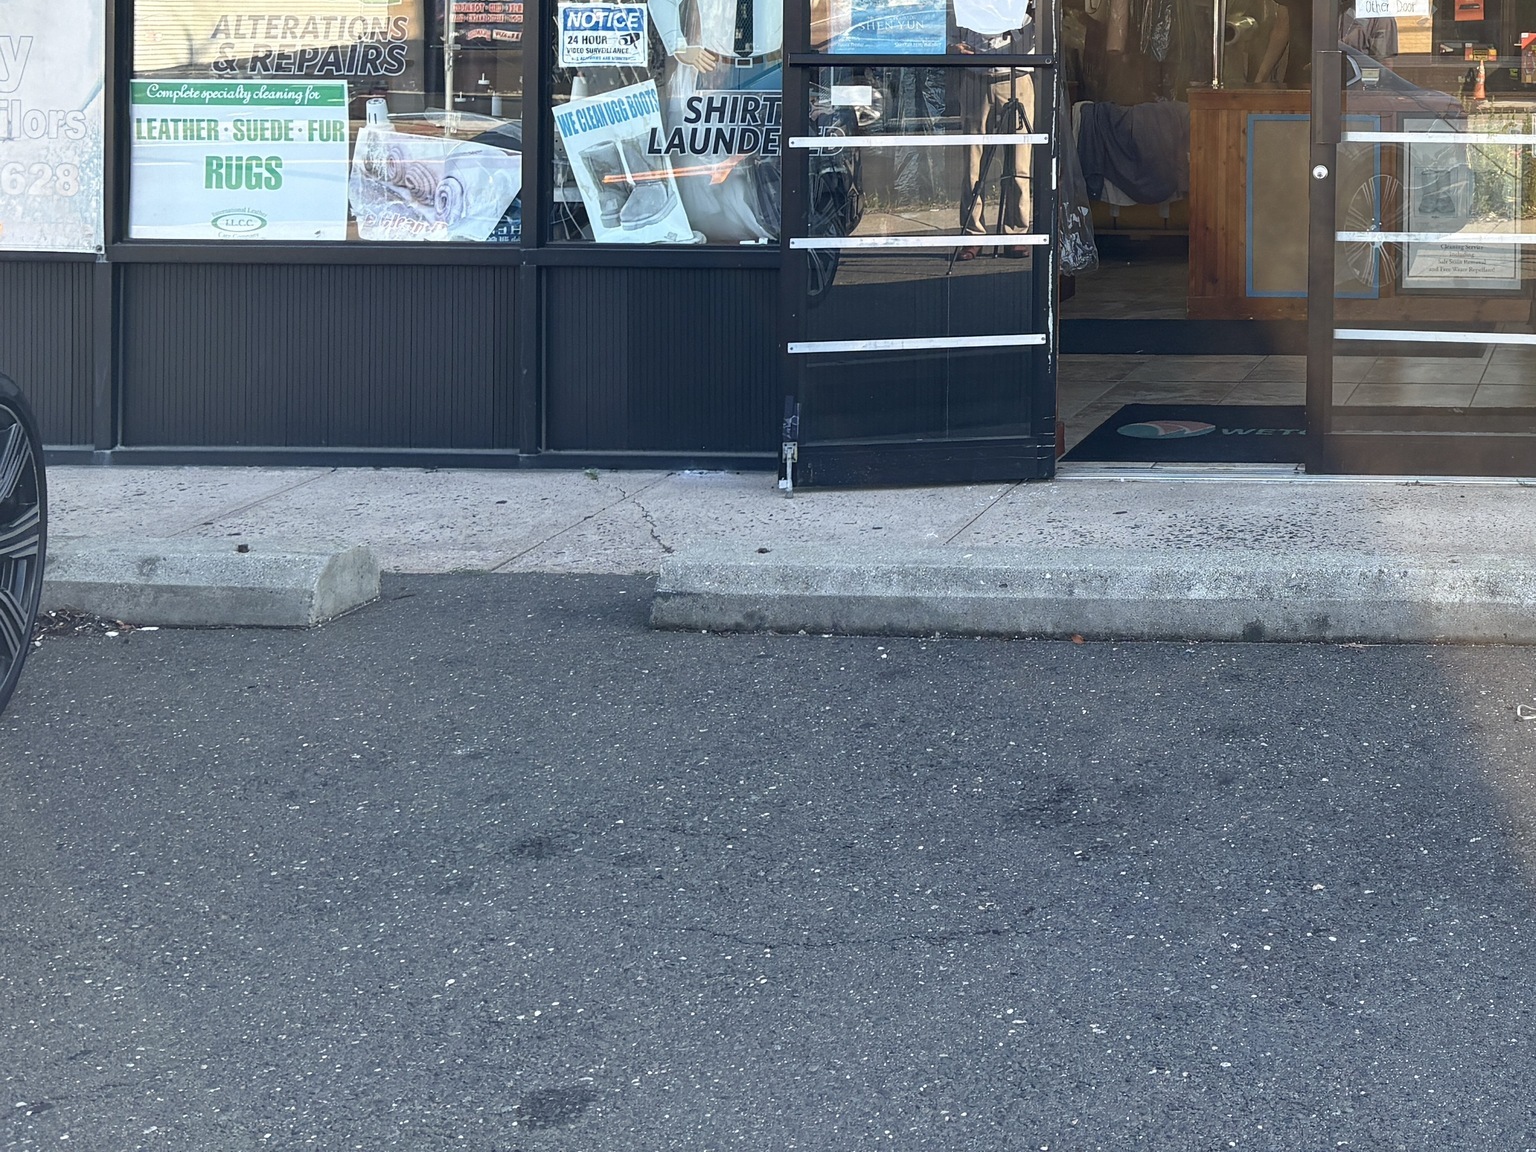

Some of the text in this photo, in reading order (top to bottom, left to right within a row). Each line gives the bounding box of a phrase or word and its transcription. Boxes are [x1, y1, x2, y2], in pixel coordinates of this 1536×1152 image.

[210, 14, 410, 43] ALTERATIONS
[567, 11, 640, 28] NOTICE
[860, 20, 924, 31] SHEN YUN
[568, 35, 607, 45] 24 HOUR
[211, 41, 408, 77] & REPAIRS
[146, 83, 321, 104] Complete specialty cleaning for
[557, 88, 659, 138] WE CLEAN UGG BOOTS
[684, 95, 782, 126] SHIRT
[136, 118, 345, 142] LEATHER SUEDE FUR
[204, 155, 283, 191] RUGS
